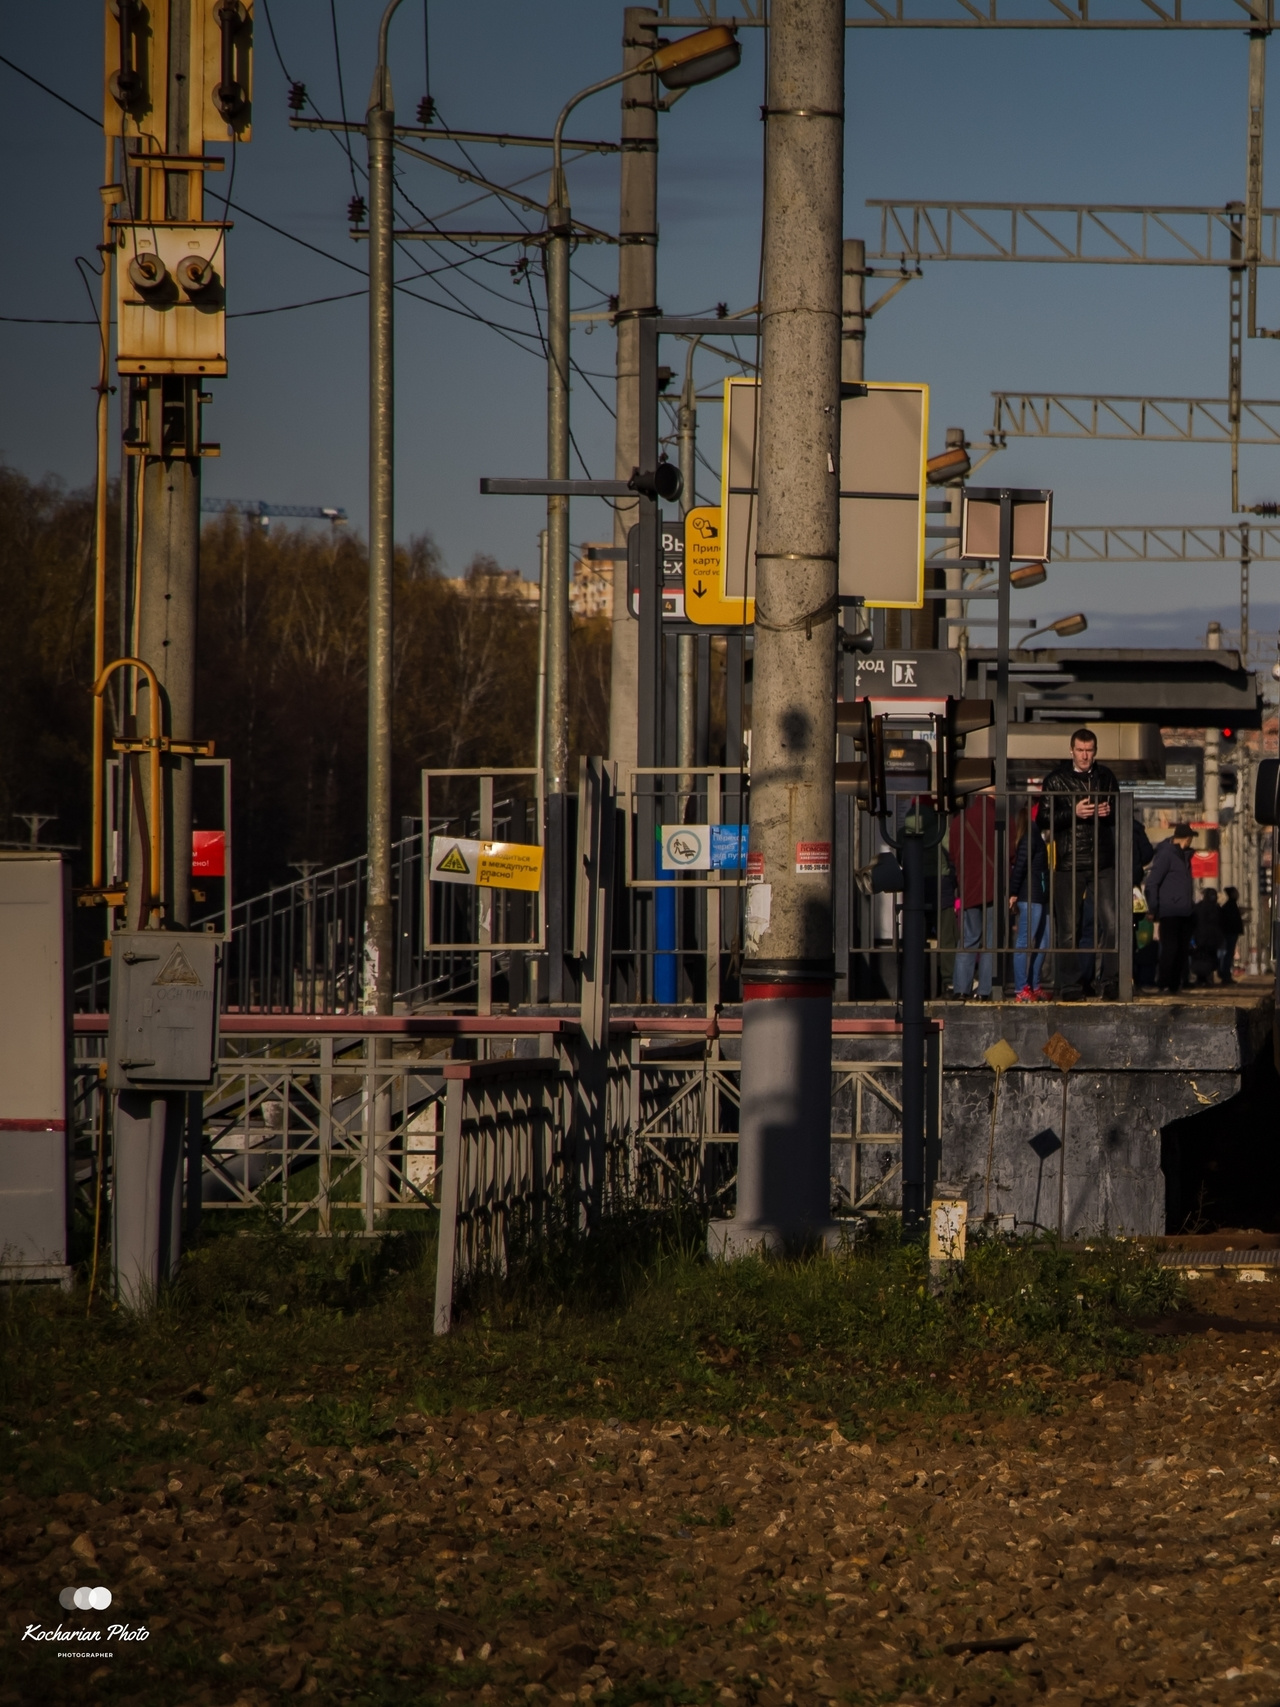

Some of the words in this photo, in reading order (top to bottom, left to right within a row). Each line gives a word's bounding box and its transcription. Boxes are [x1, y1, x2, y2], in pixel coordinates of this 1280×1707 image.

[857, 660, 885, 673] ход
[488, 861, 538, 872] междупутье
[481, 869, 514, 879] опасно!
